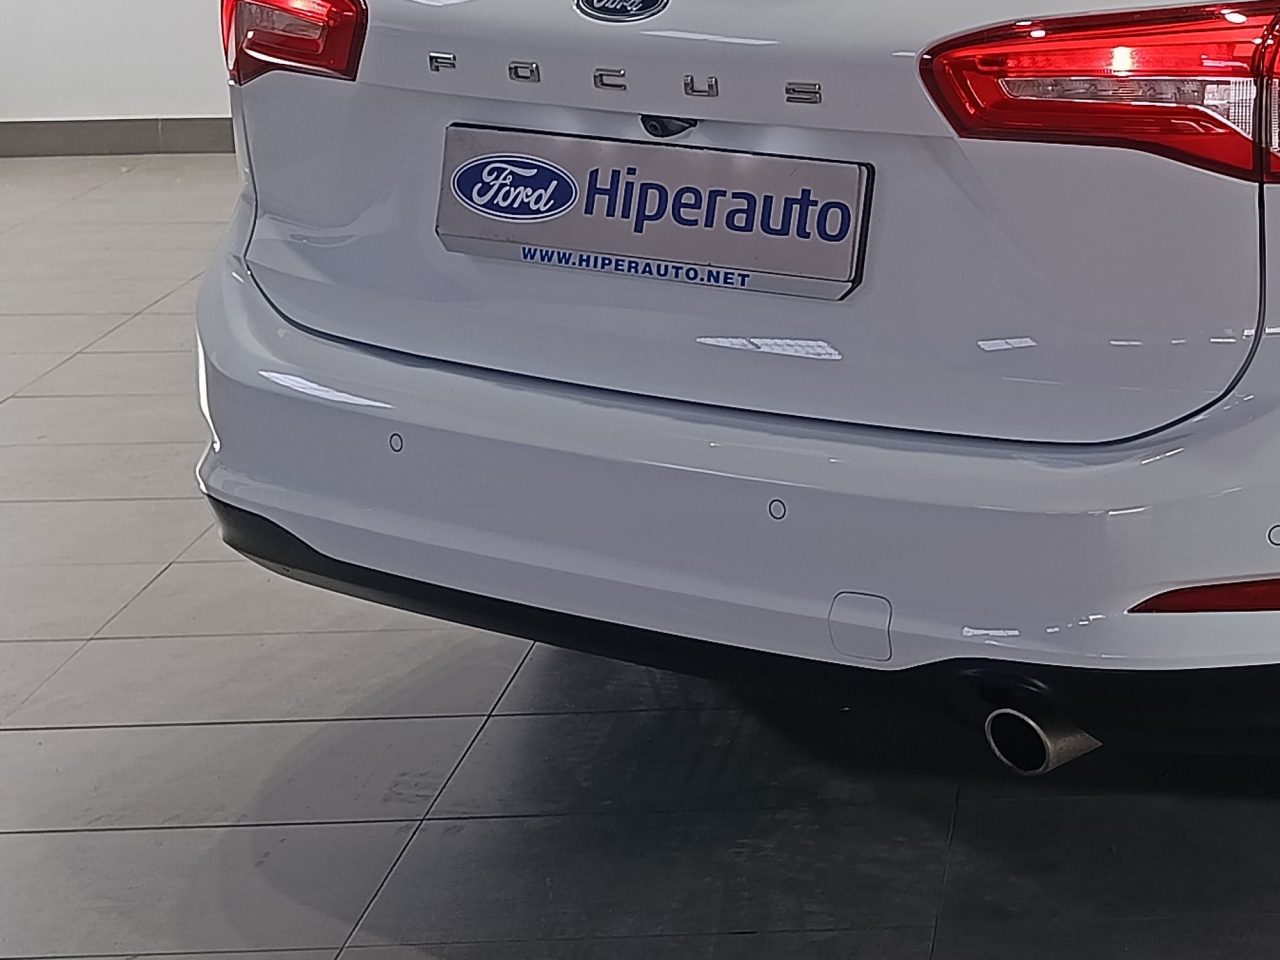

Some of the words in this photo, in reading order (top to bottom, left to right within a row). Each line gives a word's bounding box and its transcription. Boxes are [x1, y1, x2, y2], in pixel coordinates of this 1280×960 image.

[428, 51, 823, 105] FOCUS
[472, 162, 556, 213] Ford
[582, 166, 852, 244] Hiperauto
[521, 246, 751, 287] WWW.HIPERAUTO.NET
